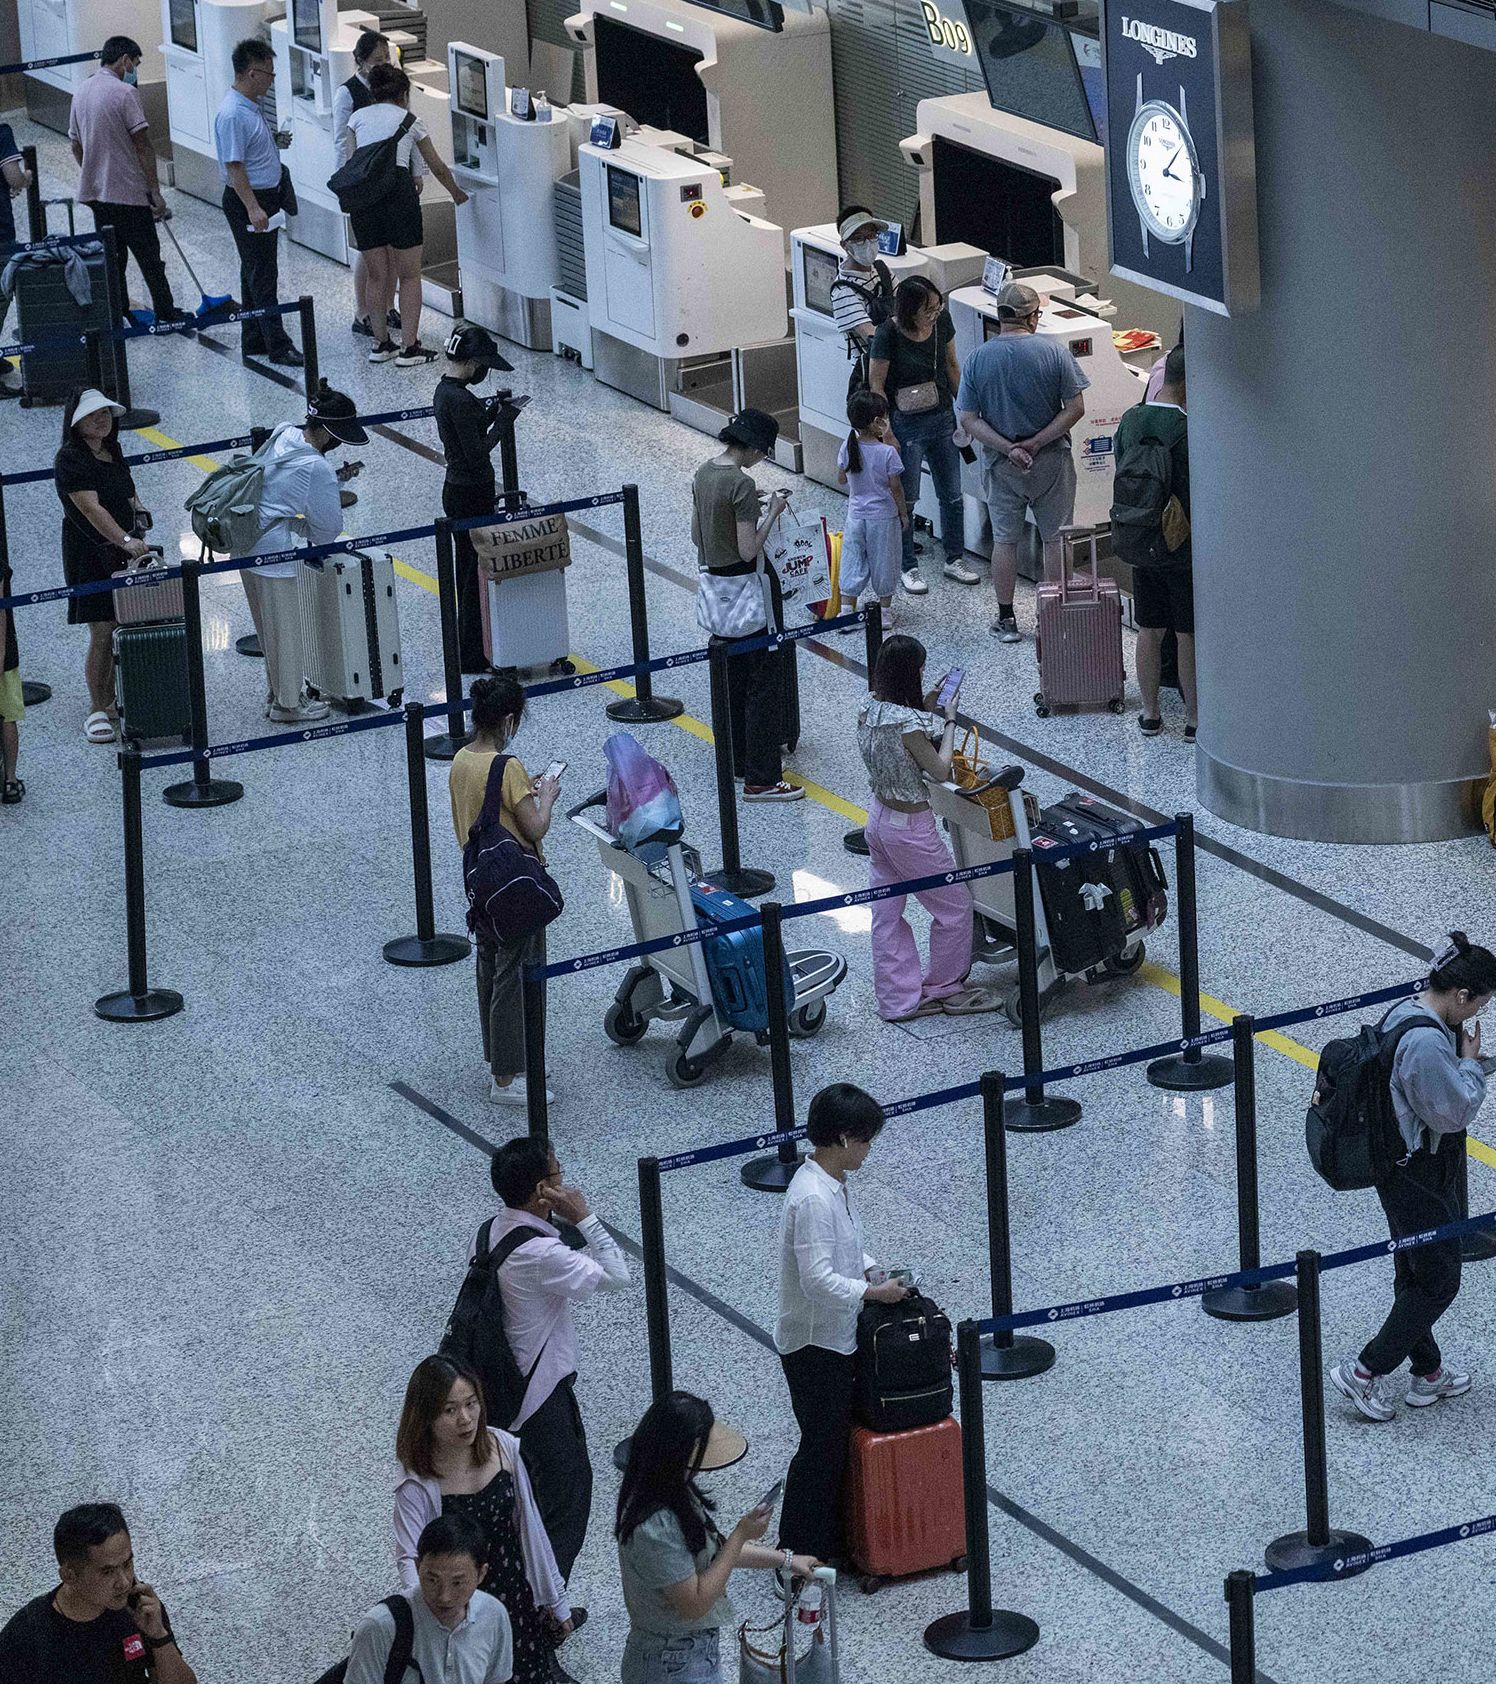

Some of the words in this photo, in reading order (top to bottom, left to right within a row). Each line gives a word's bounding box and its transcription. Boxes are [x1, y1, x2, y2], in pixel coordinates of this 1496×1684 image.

[921, 1, 972, 55] B09
[1121, 16, 1197, 58] LONGINES
[1162, 118, 1170, 130] 12
[490, 517, 559, 548] FEMME
[490, 538, 570, 573] LIBERTÉ
[782, 555, 814, 574] JUMP
